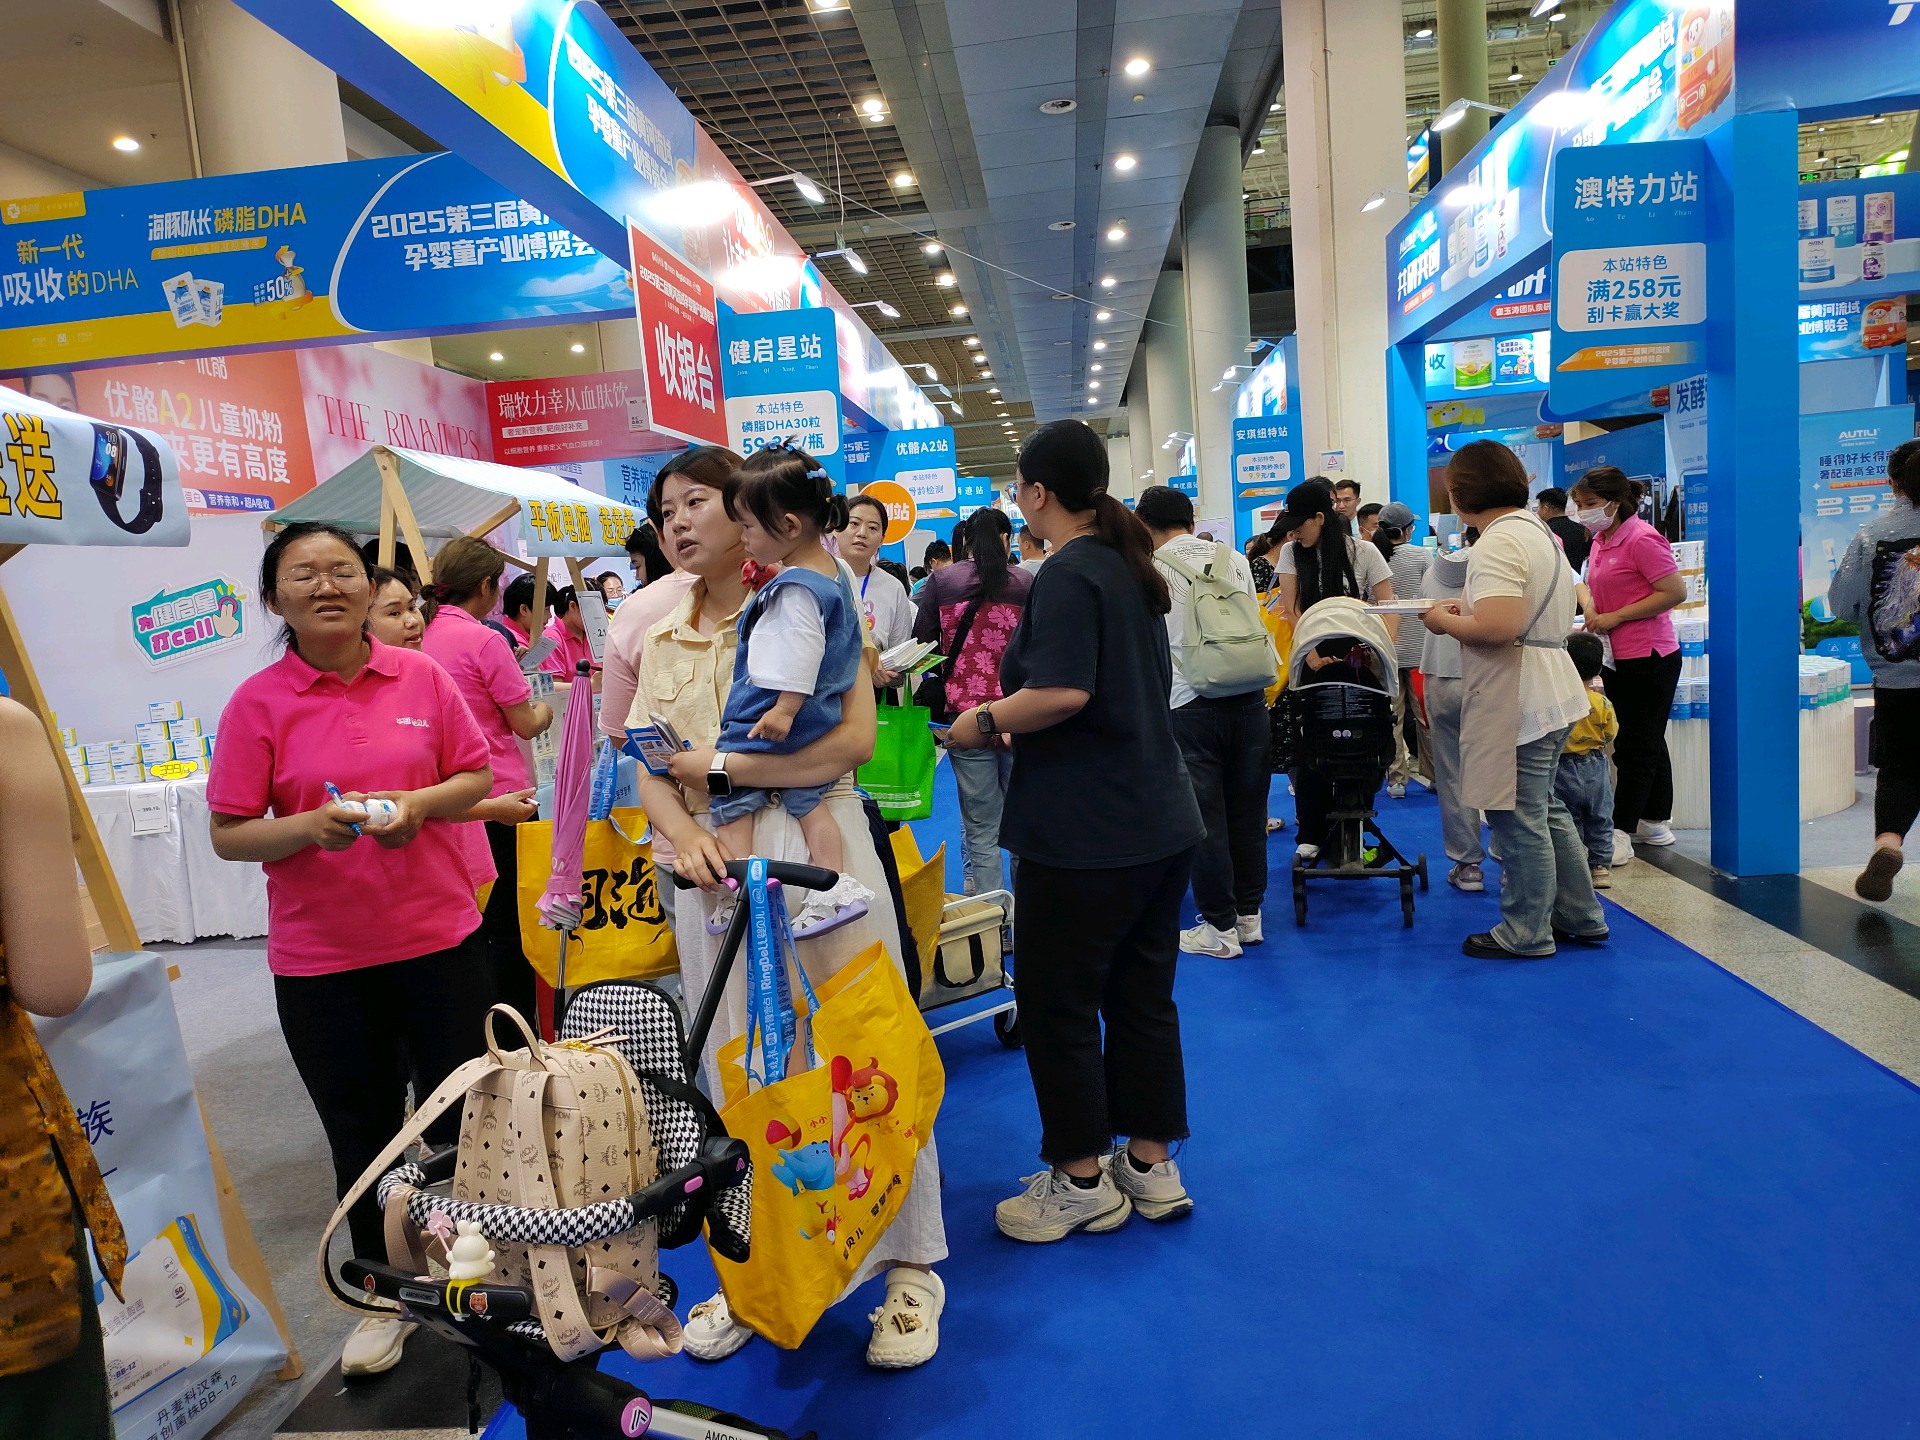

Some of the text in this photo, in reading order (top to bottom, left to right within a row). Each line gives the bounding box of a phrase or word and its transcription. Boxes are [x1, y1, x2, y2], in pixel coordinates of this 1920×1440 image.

[1574, 170, 1698, 210] 澳特力站
[17, 234, 85, 265] 新一代
[404, 230, 597, 271] 孕婴童产业博览会
[1602, 254, 1668, 274] 本站特色
[0, 267, 139, 308] 吸收的DHA
[1587, 275, 1682, 303] 满258元
[1587, 301, 1680, 324] 刮卡赢大奖
[655, 319, 717, 415] 收银台
[728, 333, 822, 366] 健启星站
[755, 400, 805, 416] 本站特色
[1676, 377, 1707, 415] 发酵
[317, 394, 375, 443] THE
[741, 415, 821, 434] 磷脂DHA30粒
[105, 442, 117, 458] 08
[138, 590, 218, 632] 为健启星
[151, 617, 214, 653] 打call
[156, 1369, 223, 1426] 丹麦科汉森
